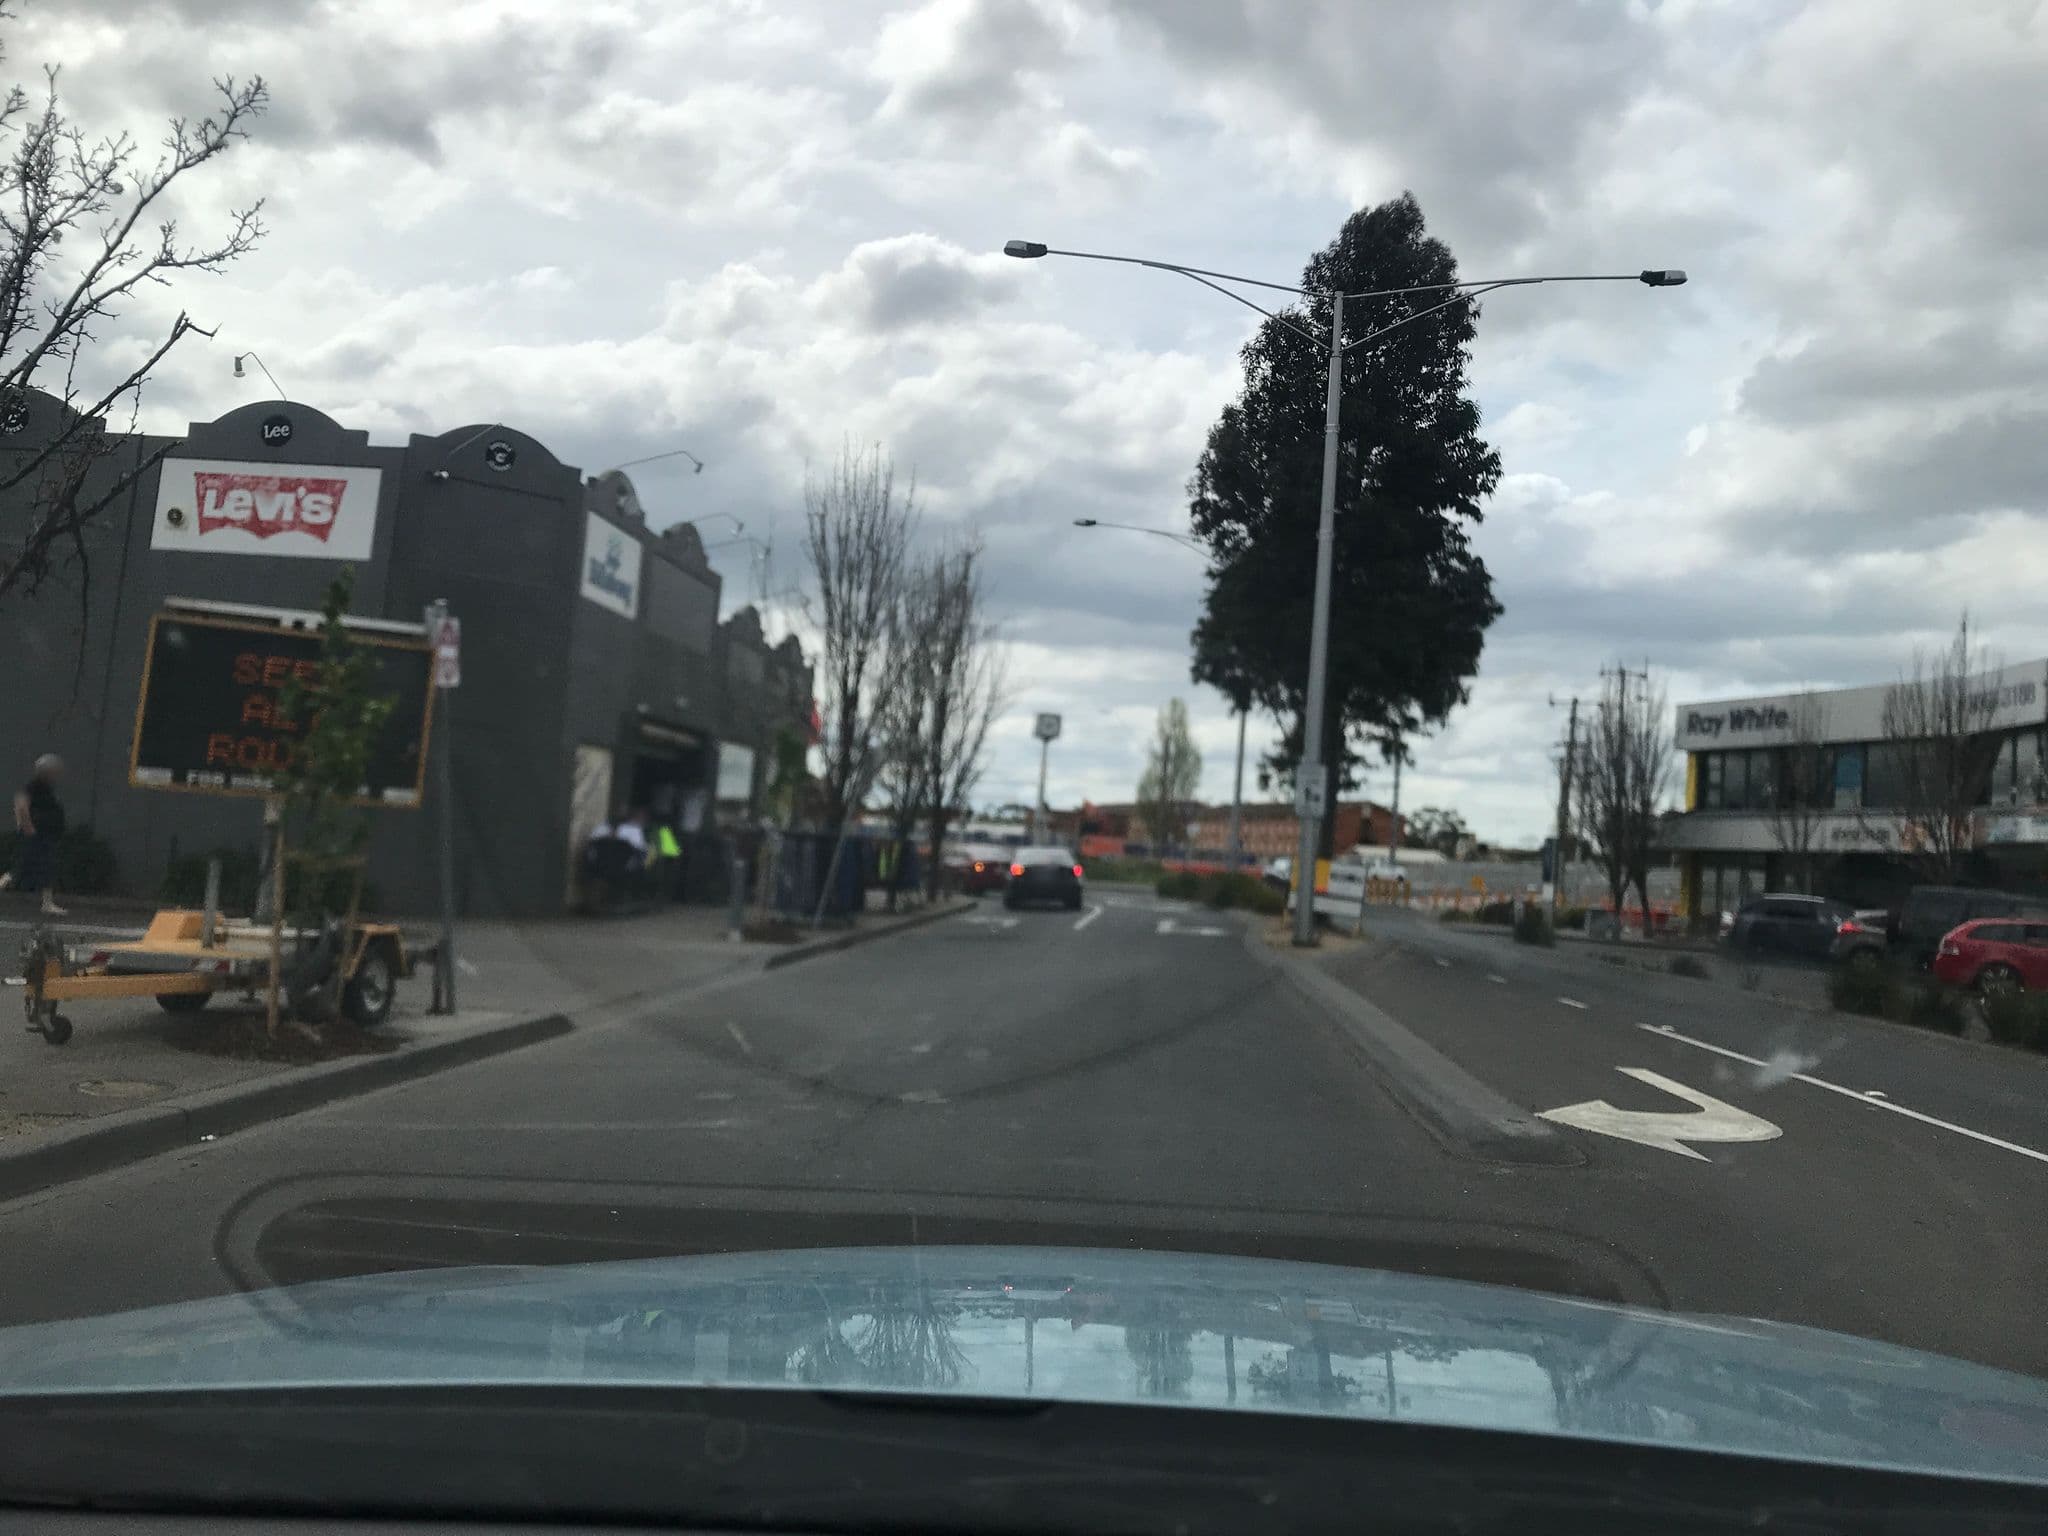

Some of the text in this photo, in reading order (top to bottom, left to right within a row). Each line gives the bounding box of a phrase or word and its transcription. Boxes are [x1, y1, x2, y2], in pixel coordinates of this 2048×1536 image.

[264, 424, 290, 439] Lee
[233, 652, 322, 692] SEE
[1686, 703, 1789, 738] Ray White
